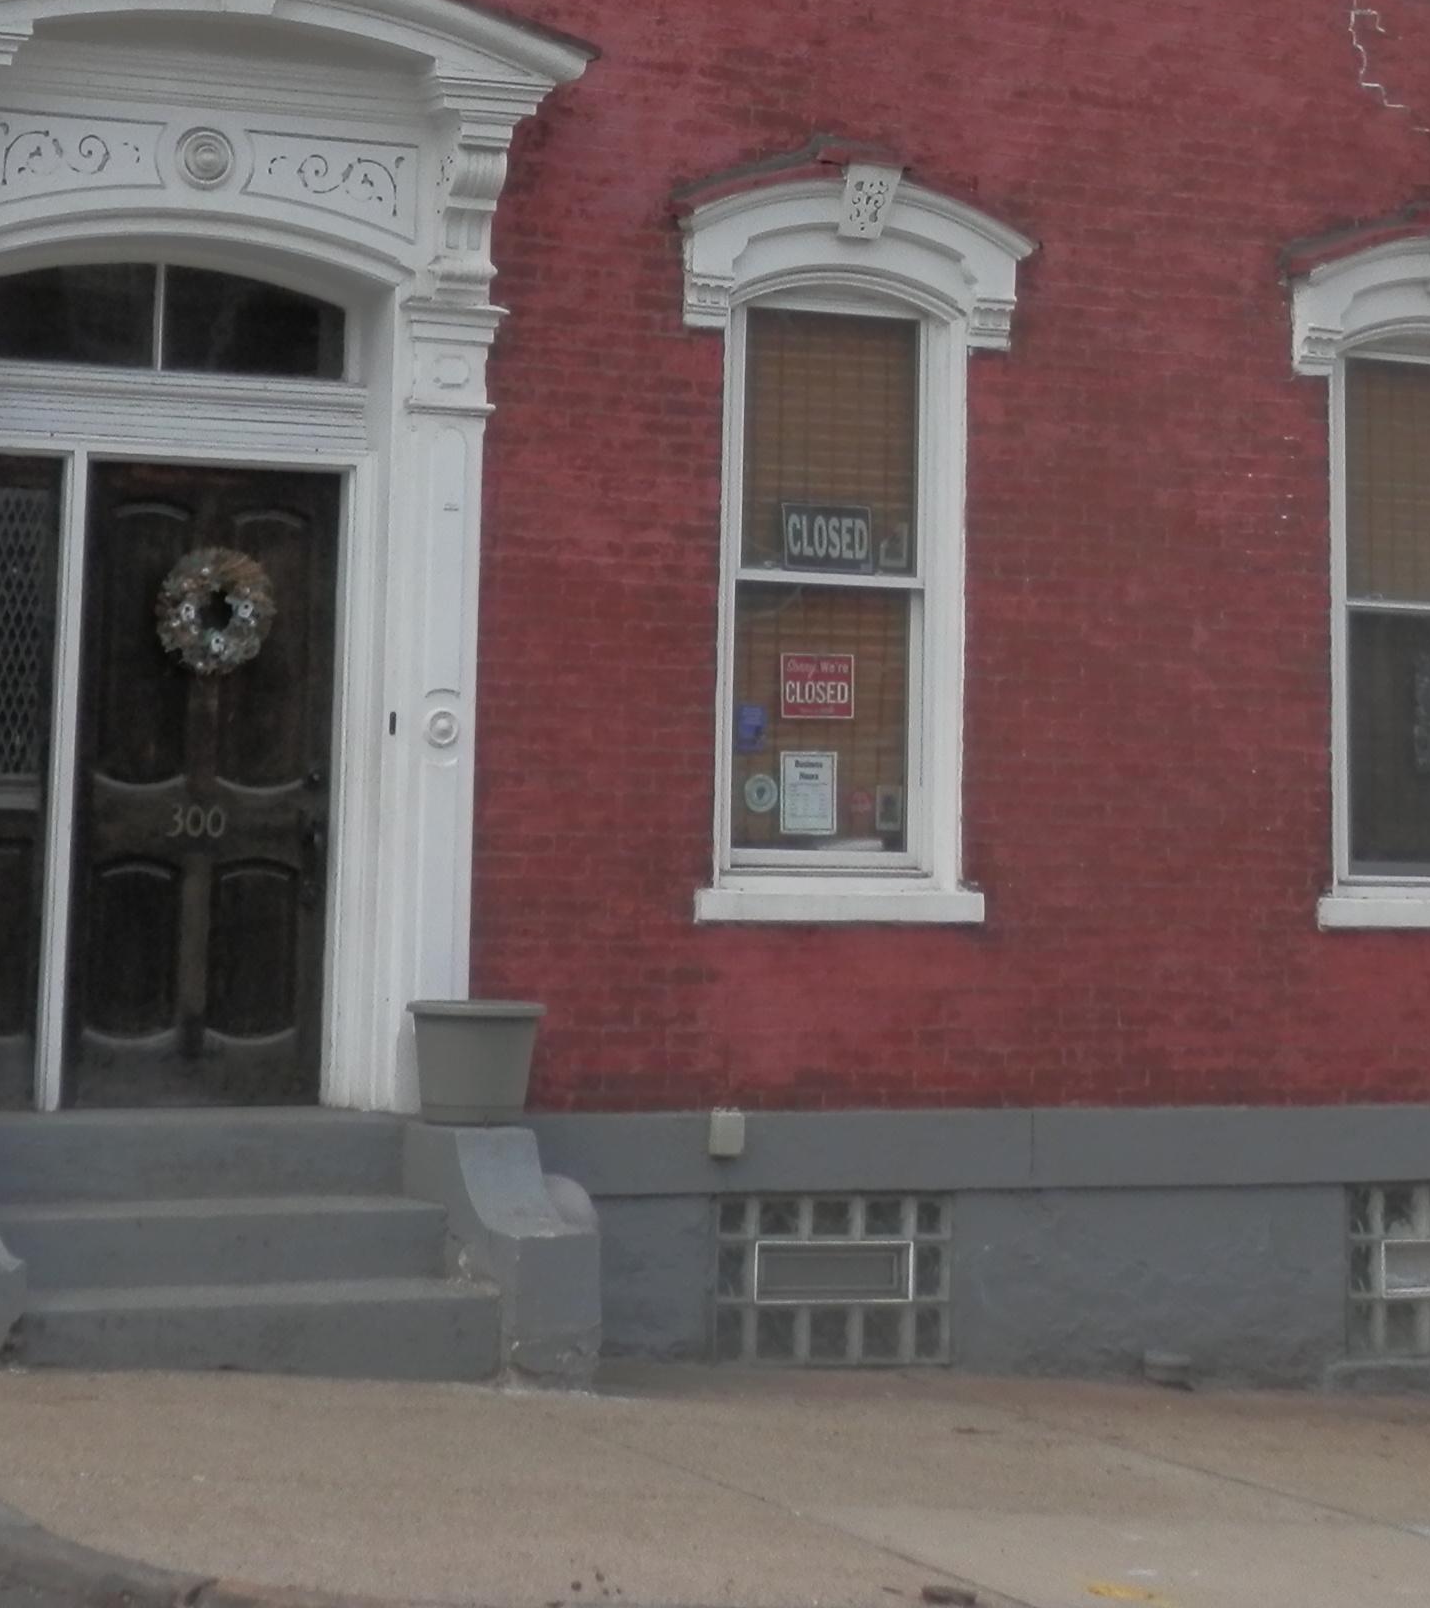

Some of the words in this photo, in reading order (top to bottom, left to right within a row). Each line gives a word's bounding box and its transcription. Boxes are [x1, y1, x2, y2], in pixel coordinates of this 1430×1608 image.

[787, 513, 868, 560] CLOSED
[786, 680, 849, 703] CLOSED
[166, 804, 227, 838] 300
